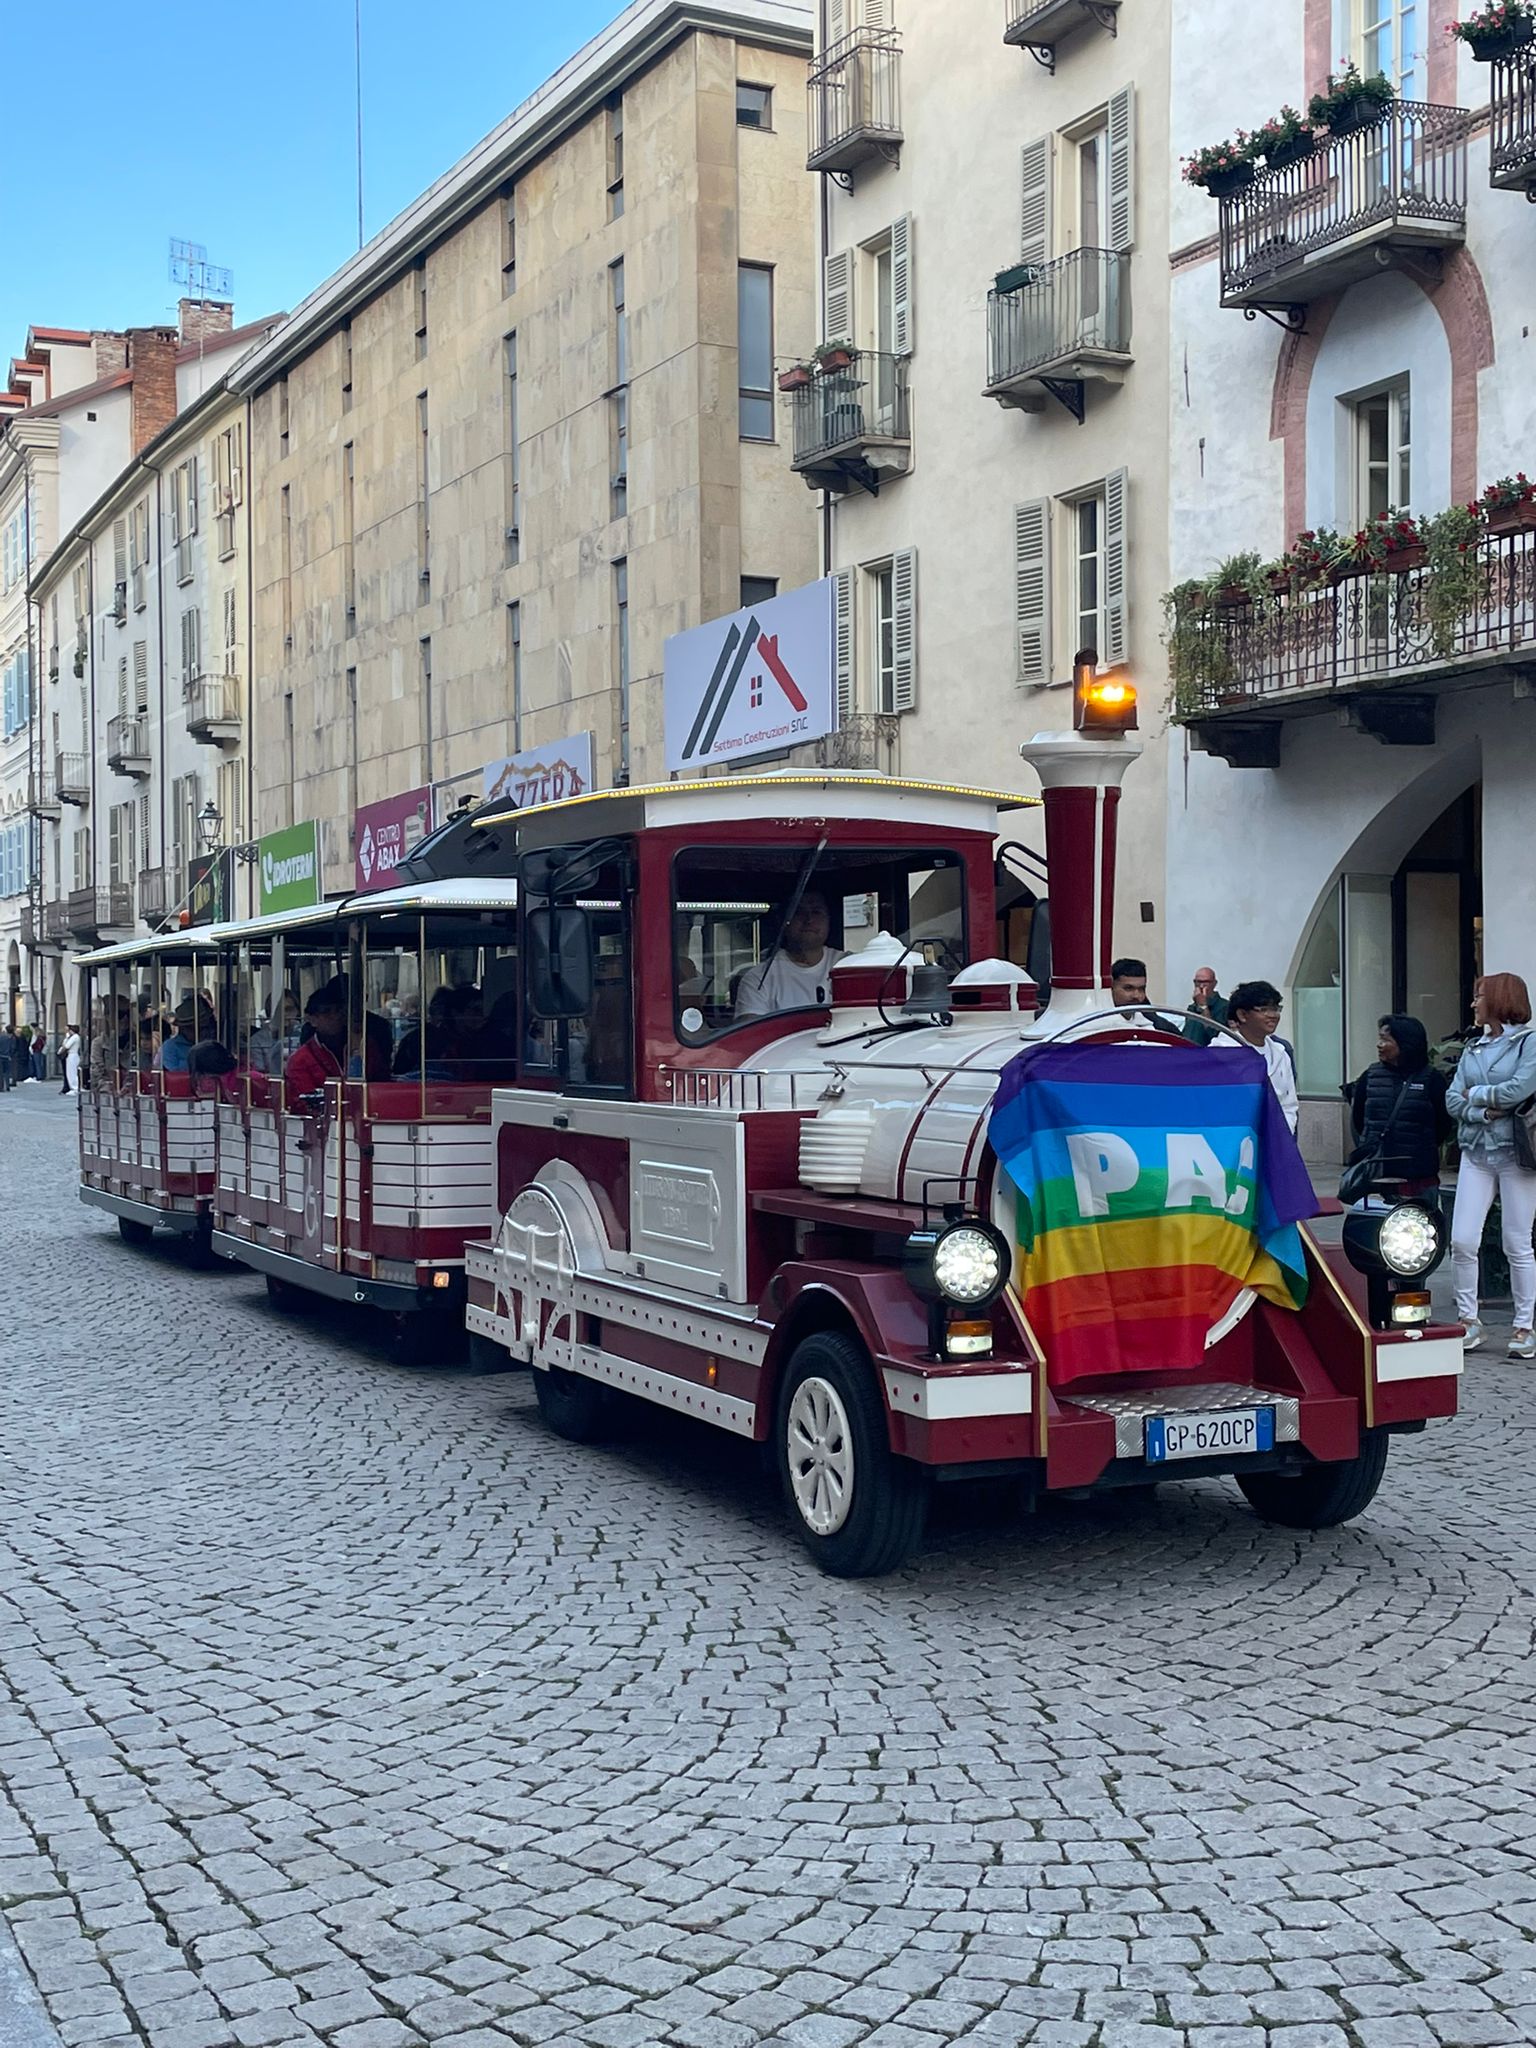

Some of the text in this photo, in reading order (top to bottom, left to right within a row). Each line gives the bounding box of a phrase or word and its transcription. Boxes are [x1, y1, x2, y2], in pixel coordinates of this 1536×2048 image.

[744, 724, 790, 745] Costruzioni
[376, 823, 401, 847] CENTRO
[273, 851, 314, 888] IDROTERM
[376, 843, 401, 872] ABAX
